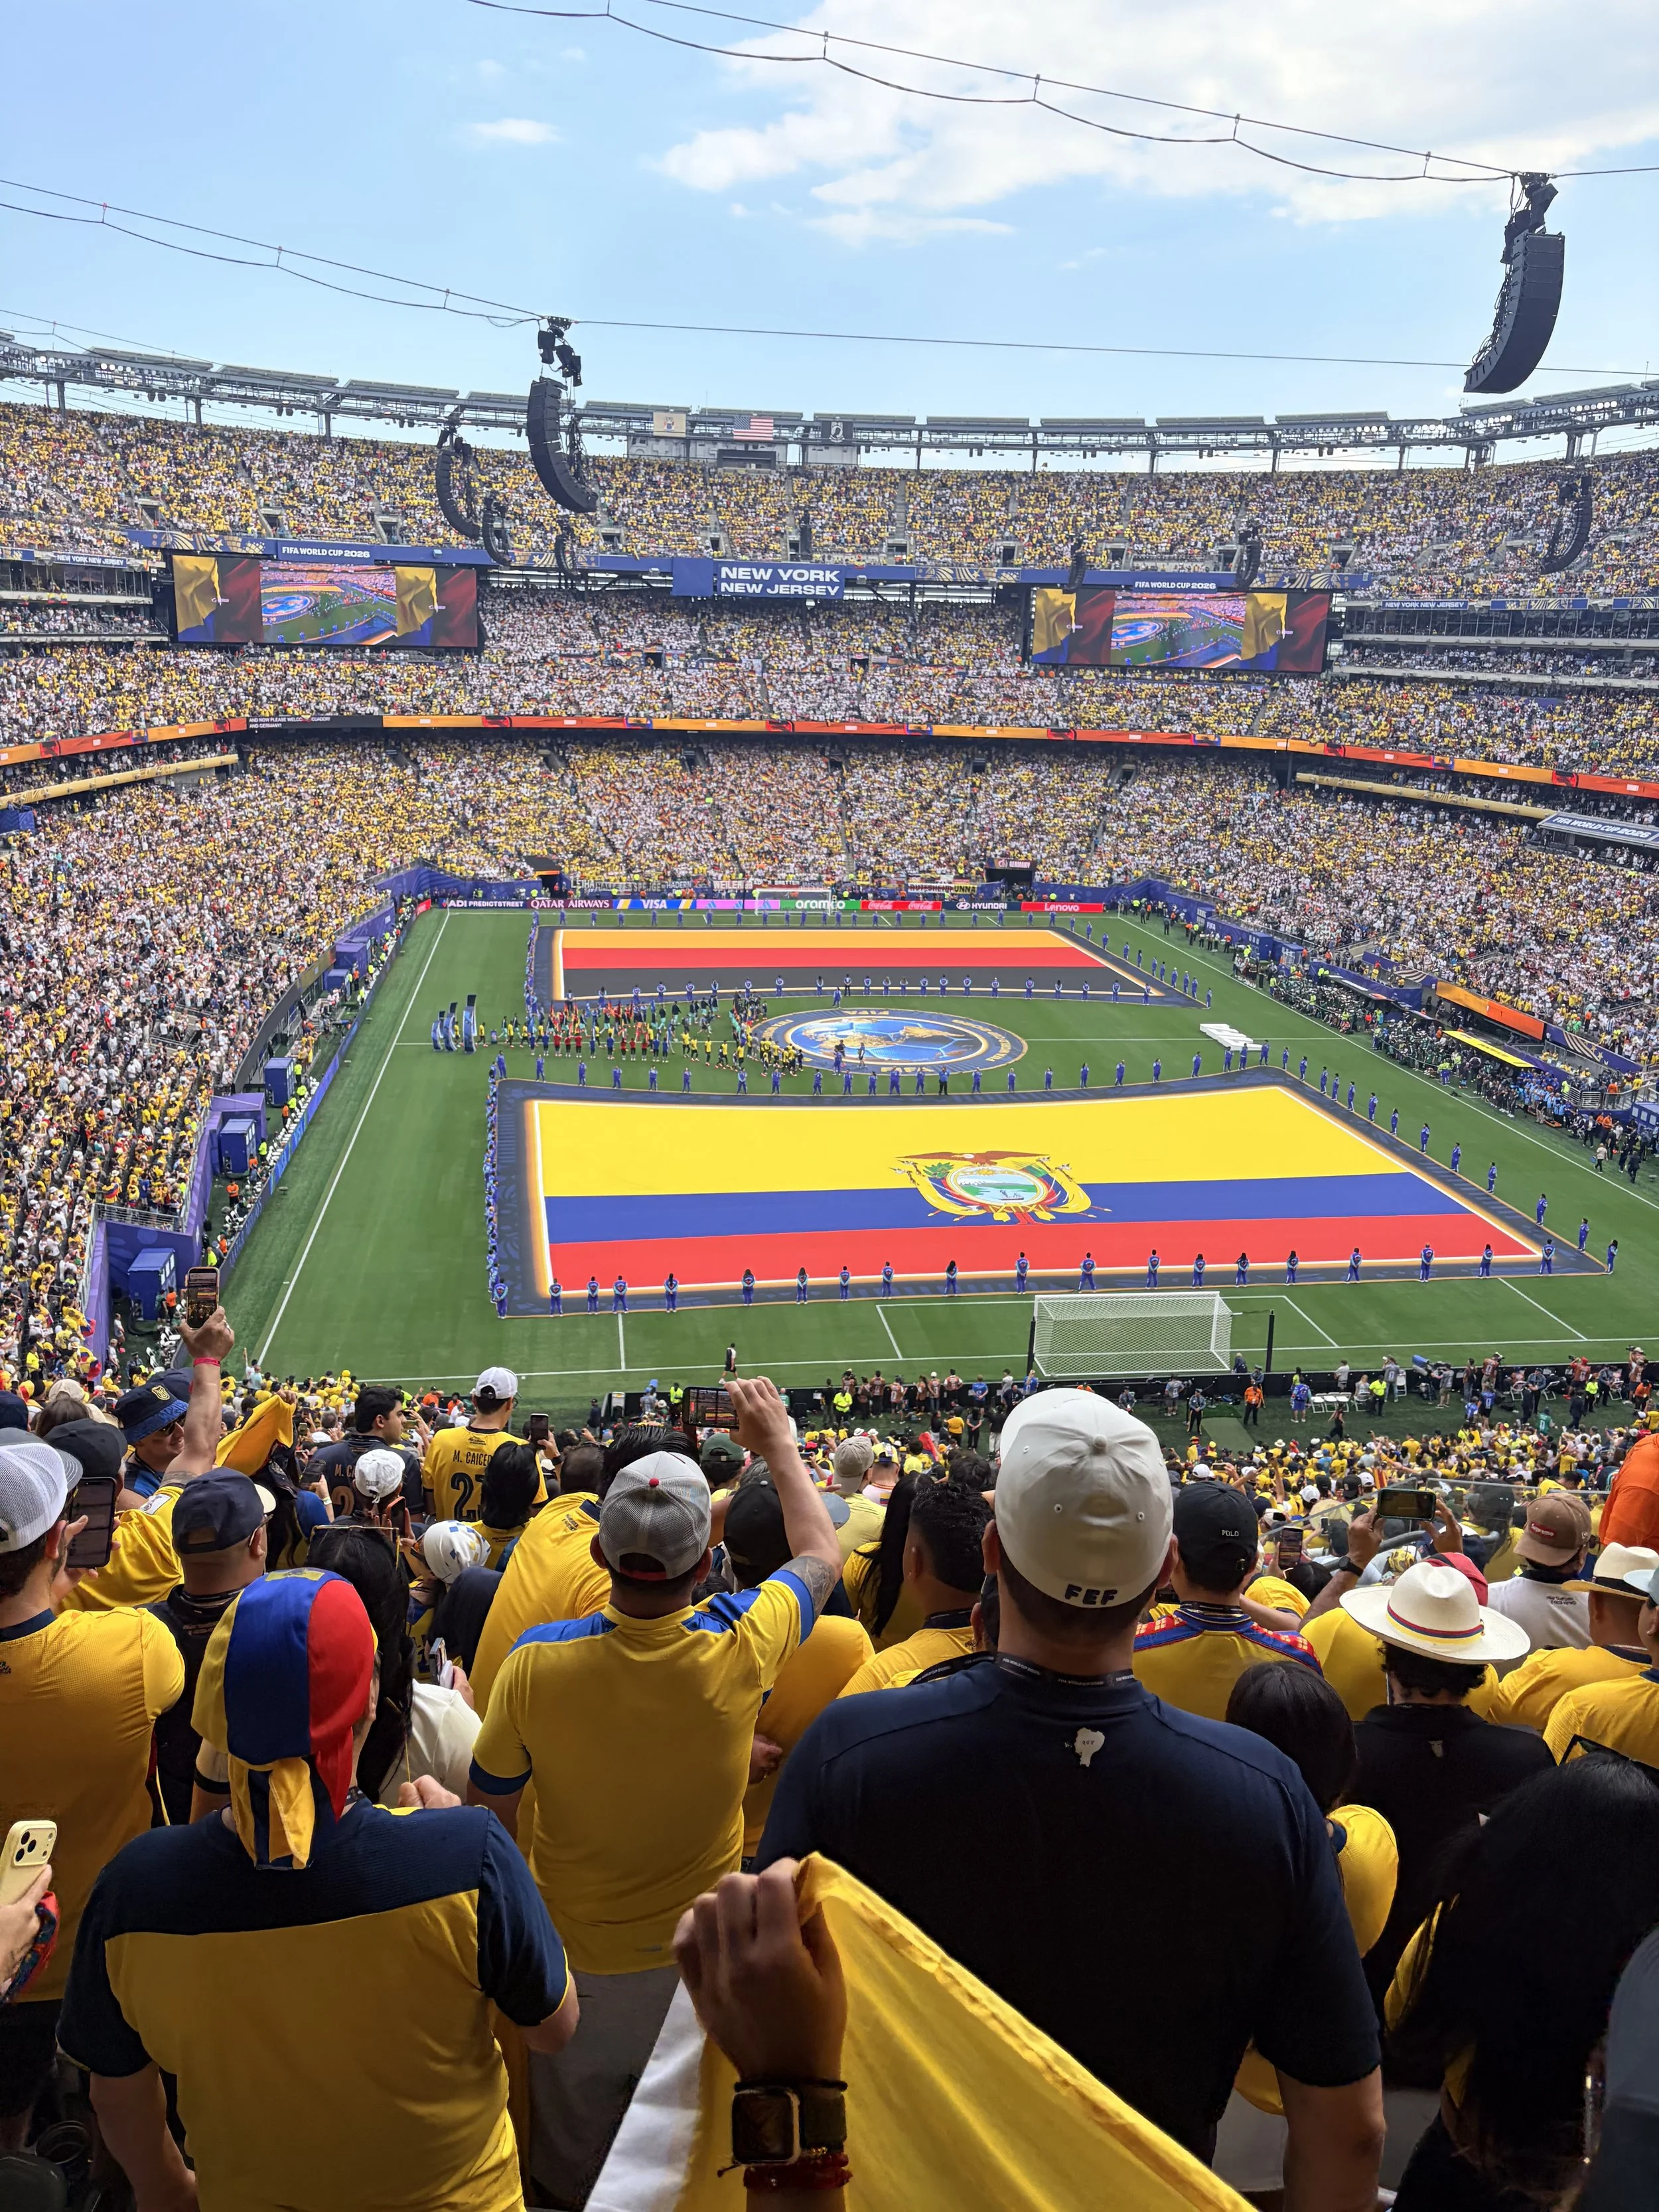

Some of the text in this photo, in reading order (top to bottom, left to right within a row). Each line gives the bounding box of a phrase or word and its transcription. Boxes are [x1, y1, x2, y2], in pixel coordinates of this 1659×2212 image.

[721, 567, 841, 583] NEW YORK
[720, 582, 840, 596] NEW JERSEY
[1571, 820, 1603, 831] WORLD
[1600, 825, 1620, 834] CUP
[1617, 828, 1652, 838] 2026
[530, 899, 610, 909] QATAR AIRWAYS
[640, 899, 668, 909] VISA
[1045, 903, 1080, 911] Lenovo
[453, 1449, 463, 1463] M.
[334, 1463, 344, 1477] M.
[1064, 1584, 1118, 1605] FEF
